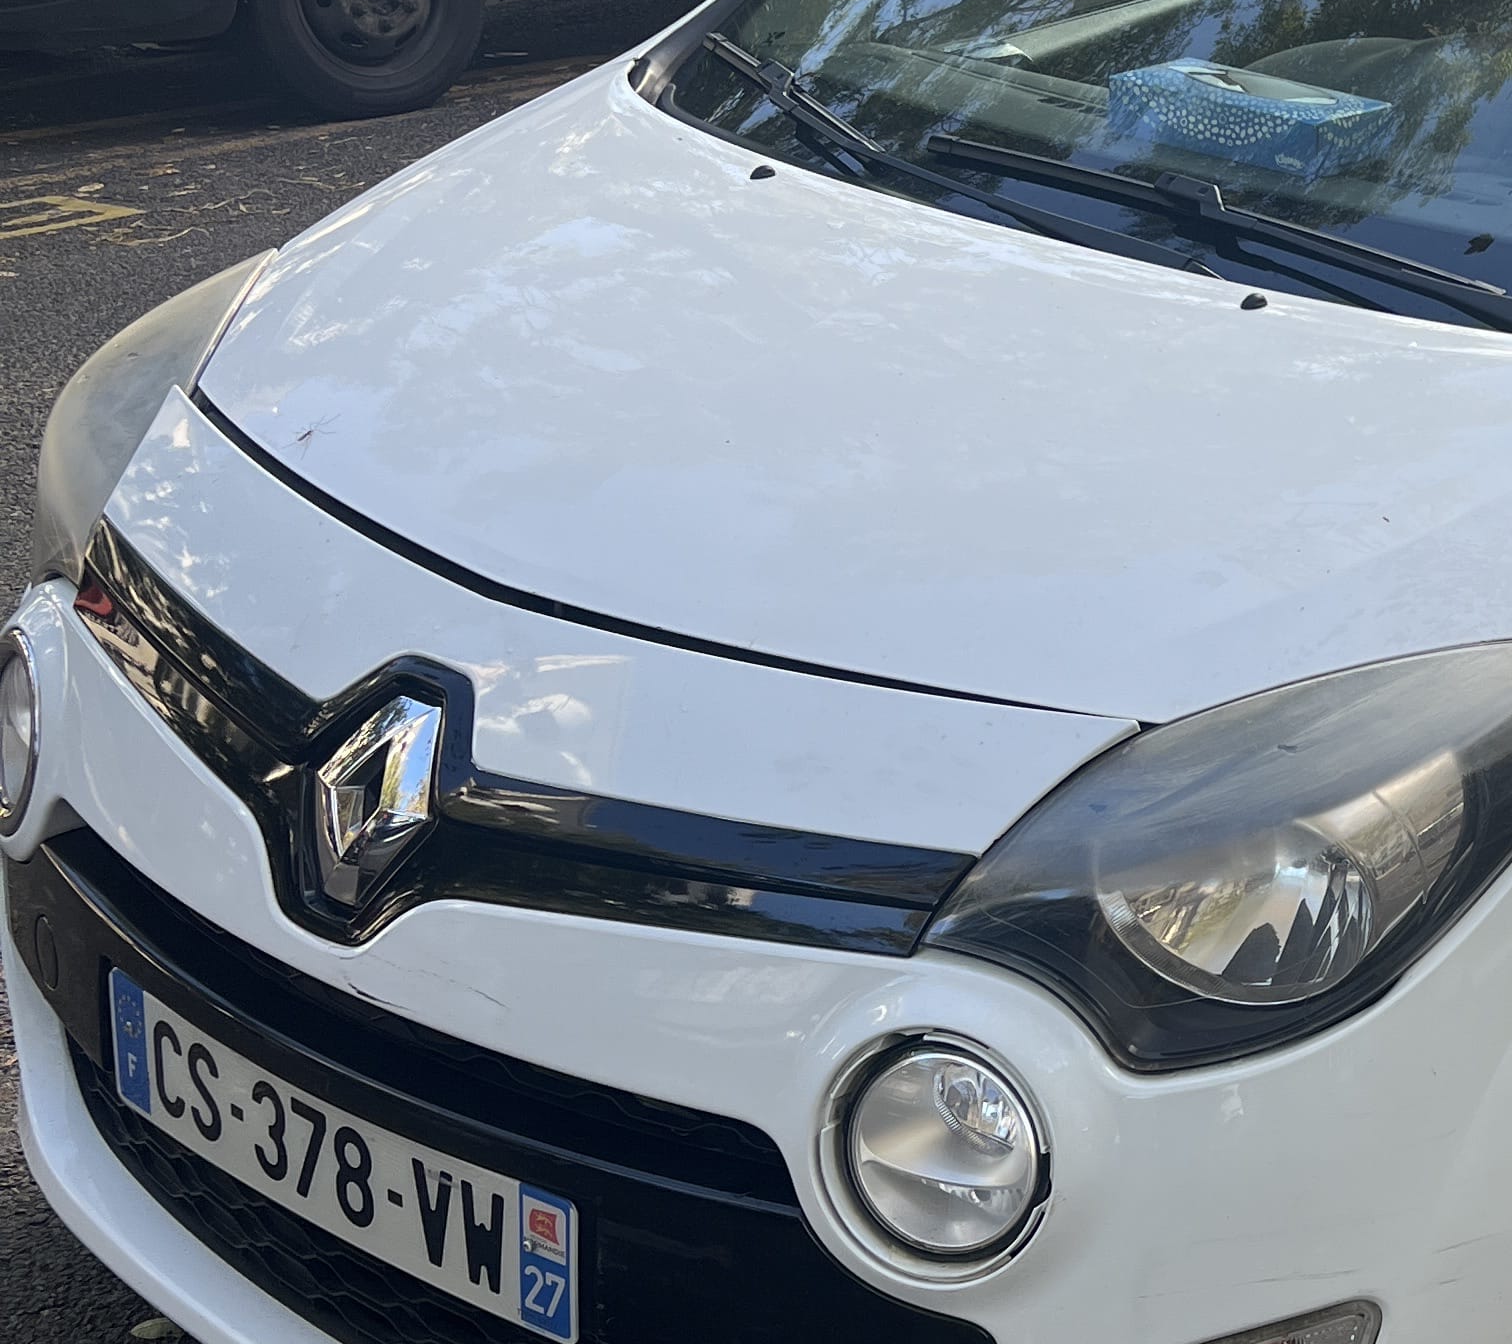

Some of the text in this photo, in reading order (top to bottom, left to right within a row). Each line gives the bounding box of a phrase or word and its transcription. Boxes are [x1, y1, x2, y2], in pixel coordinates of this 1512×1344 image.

[127, 1053, 138, 1078] F
[153, 1020, 505, 1294] CS-378-VW
[524, 1265, 566, 1318] 27
